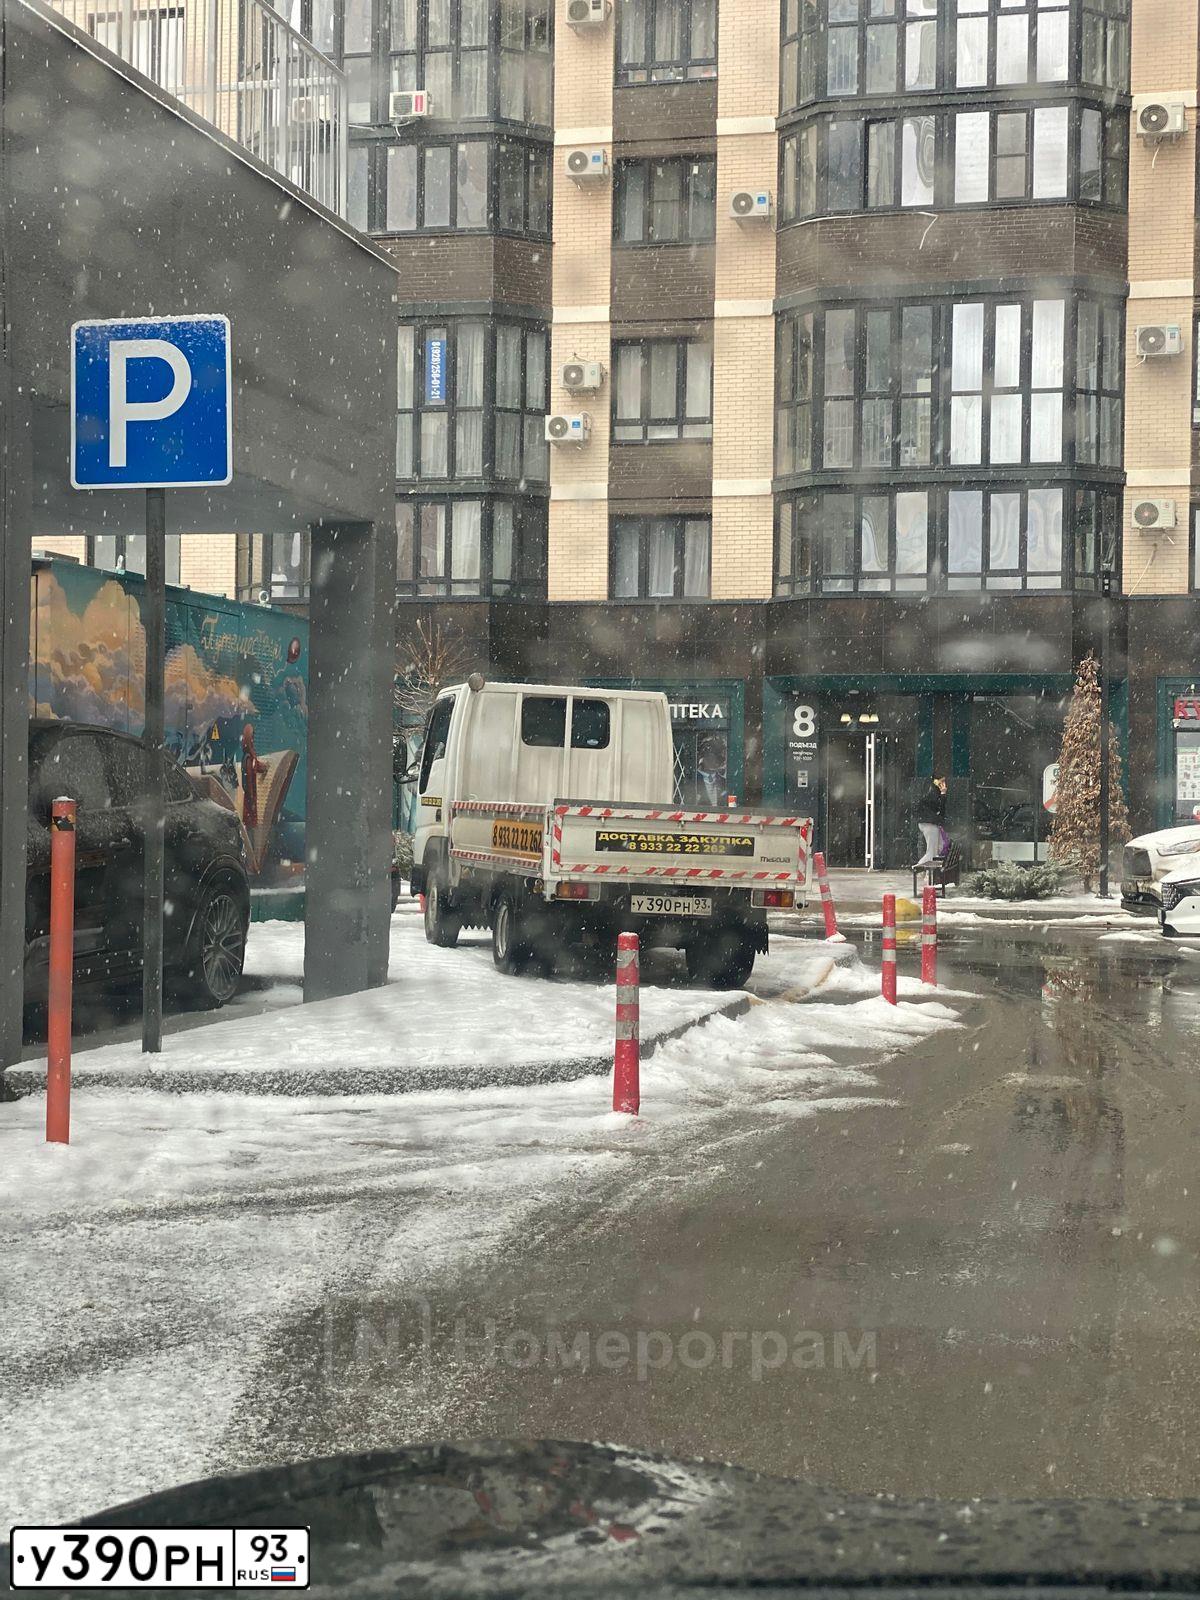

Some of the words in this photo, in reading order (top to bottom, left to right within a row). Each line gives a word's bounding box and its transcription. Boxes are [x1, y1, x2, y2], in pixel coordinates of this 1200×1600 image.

[109, 339, 192, 467] P
[793, 705, 815, 738] 8
[493, 825, 498, 847] 8
[499, 826, 510, 849] 933
[598, 832, 674, 842] ДОСТАВКА
[679, 835, 752, 845] ЗАКУПКА
[640, 843, 663, 851] 933
[666, 843, 681, 852] 22
[685, 844, 699, 852] 22
[703, 845, 726, 853] 262
[694, 898, 707, 910] 93
